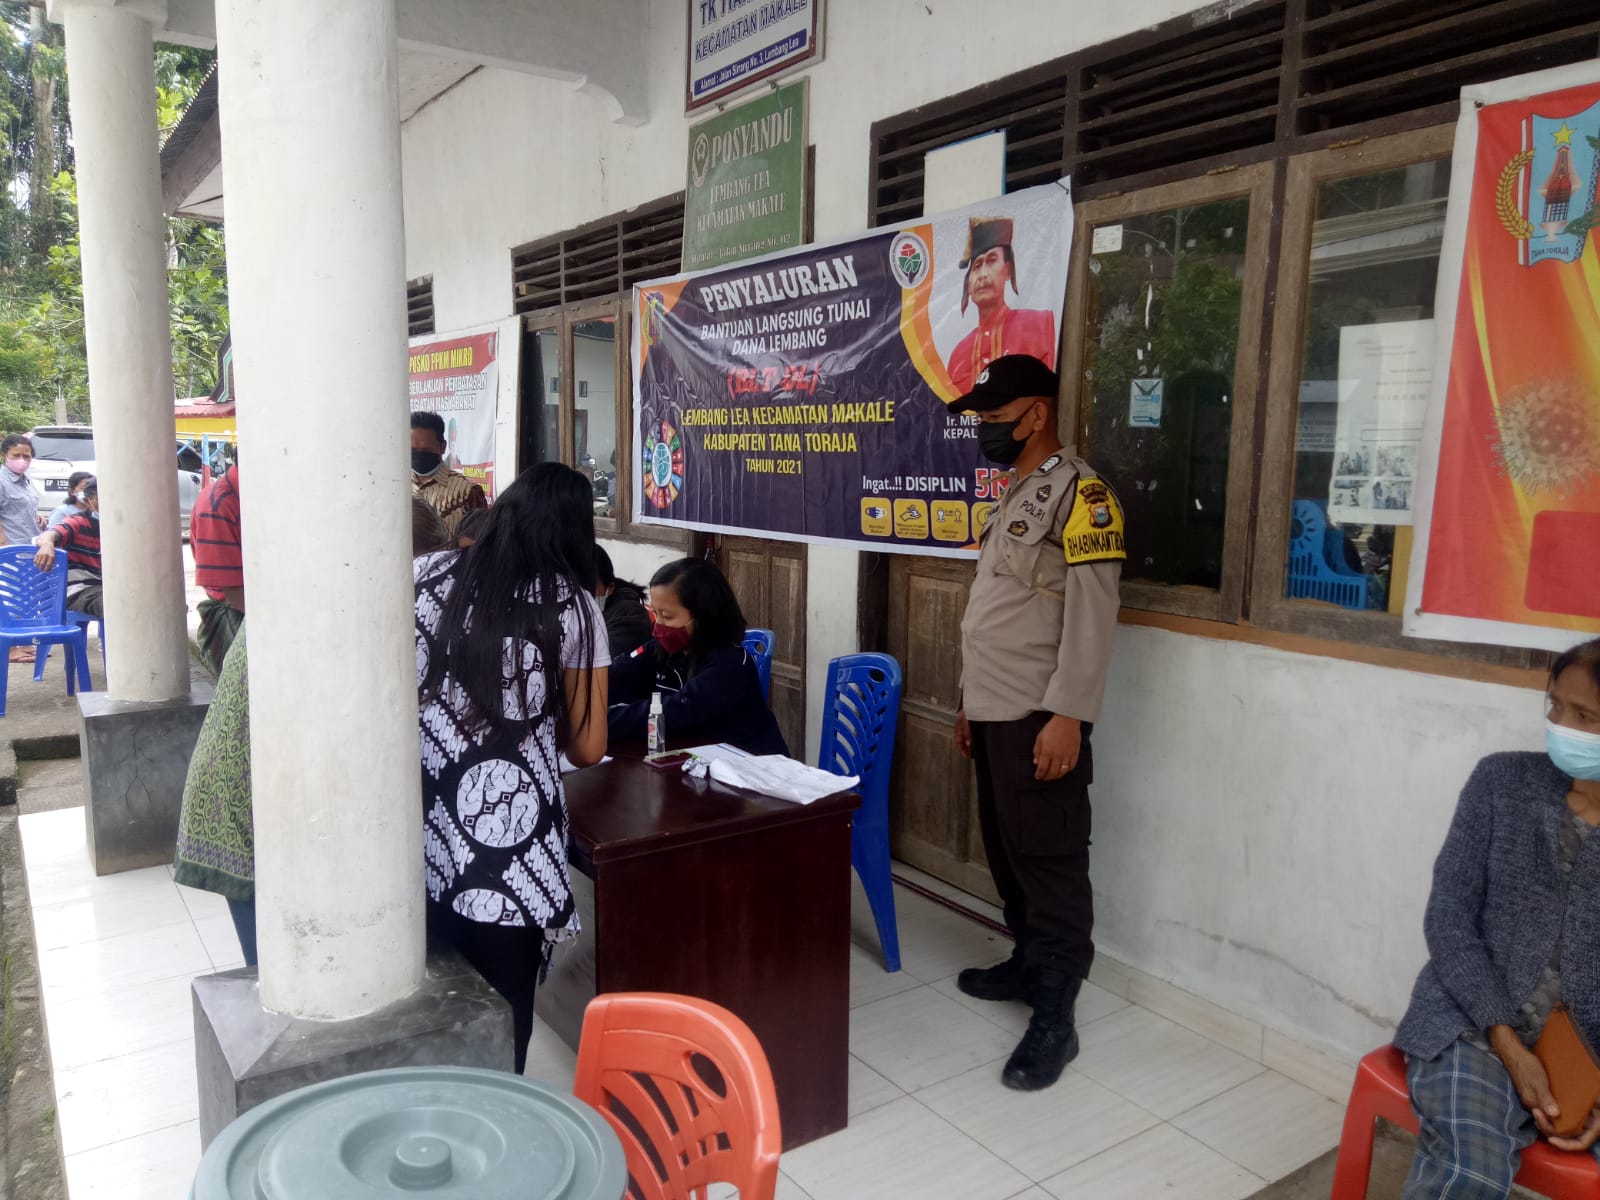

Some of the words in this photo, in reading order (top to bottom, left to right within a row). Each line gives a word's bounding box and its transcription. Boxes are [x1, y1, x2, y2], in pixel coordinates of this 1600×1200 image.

[695, 9, 758, 63] KECAMATAN
[719, 68, 732, 82] Jalan
[764, 41, 788, 61] Lembang
[788, 36, 799, 50] Lea
[711, 106, 793, 169] POSYANDU
[710, 175, 751, 206] LEMBANG
[754, 170, 770, 193] LEA
[697, 203, 746, 233] KECAMATAN
[748, 191, 786, 219] MAKALE
[699, 254, 858, 313] PENYALURAN
[701, 318, 753, 341] BANTUAN
[756, 306, 824, 334] LANGSUNG
[827, 298, 871, 324] TUNAI
[731, 337, 766, 356] DANA
[769, 328, 828, 353] LEMBANG
[409, 353, 430, 374] POSKO
[431, 350, 449, 371] PPKM
[451, 346, 473, 369] MIKRO
[445, 372, 488, 392] PEMBATASAN
[680, 407, 728, 427] LEMBANG
[731, 406, 750, 426] LEA
[752, 403, 828, 426] KECAMATAN
[831, 400, 896, 424] MAKALE
[946, 415, 957, 427] Ir.
[703, 432, 766, 452] KABUPATEN
[768, 433, 801, 452] TANA
[804, 432, 858, 453] TORAJA
[745, 458, 774, 474] TAHUN
[776, 459, 802, 475] 2021
[905, 476, 966, 493] DISIPLIN
[1020, 500, 1046, 521] POLRI
